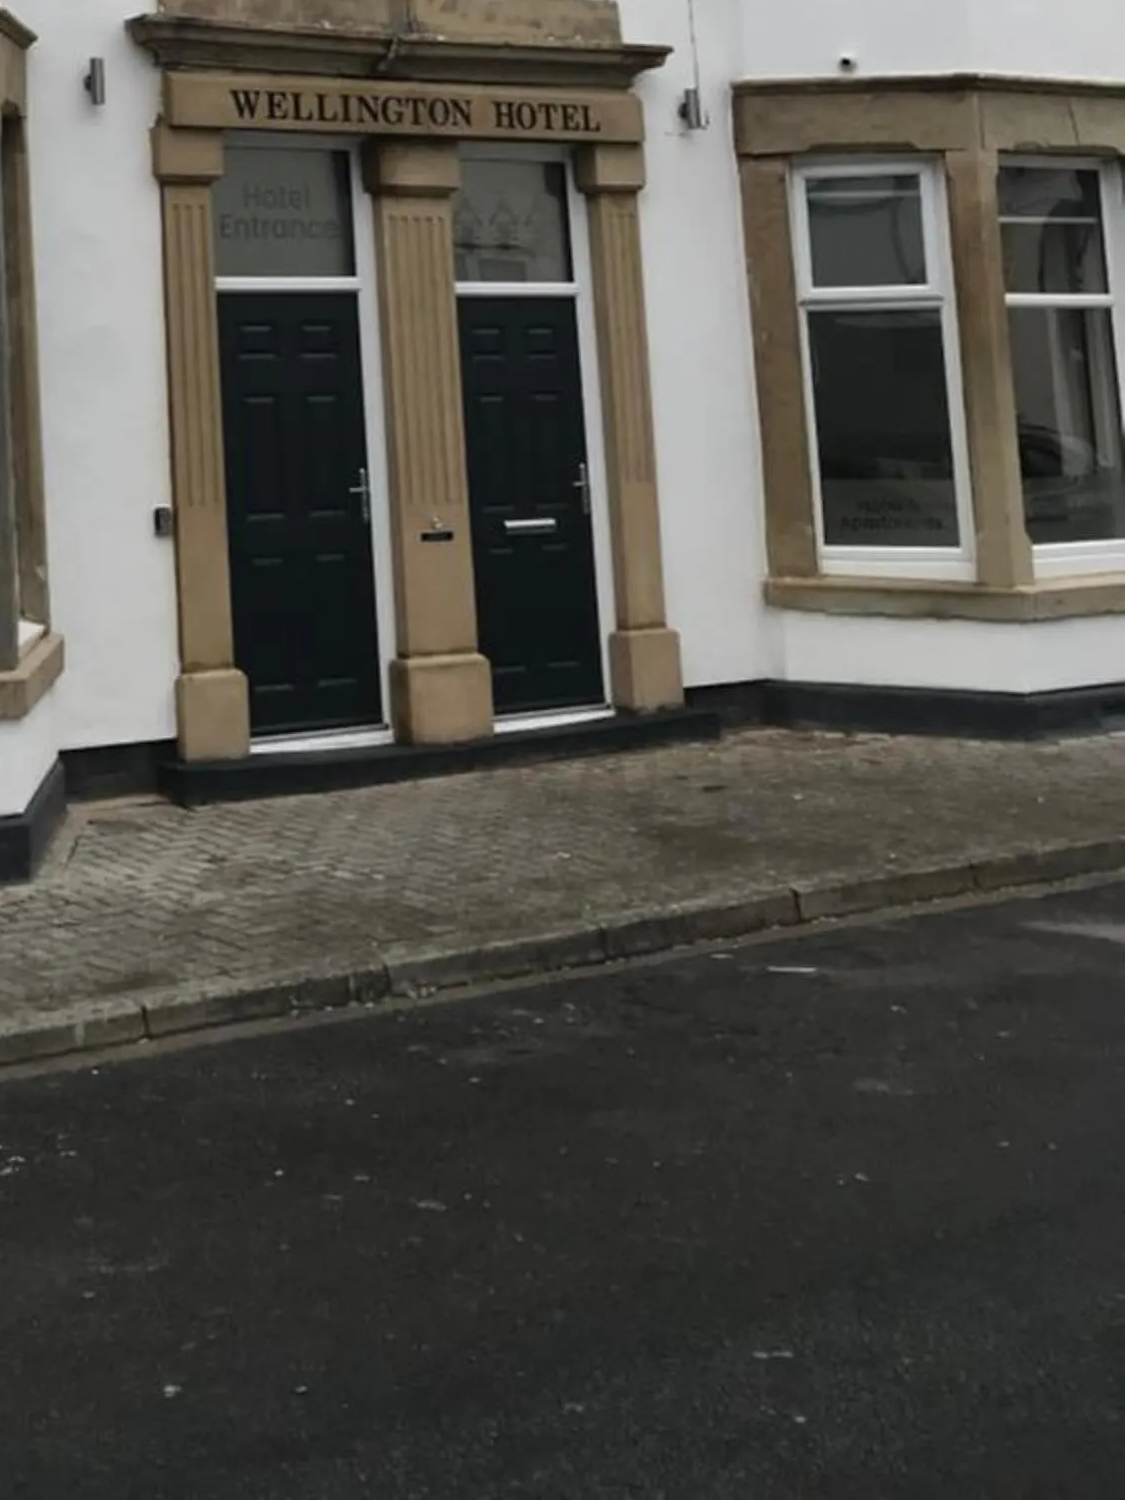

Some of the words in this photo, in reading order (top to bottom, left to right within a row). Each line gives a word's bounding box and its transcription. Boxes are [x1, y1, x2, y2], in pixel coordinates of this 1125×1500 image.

[230, 89, 473, 128] WELLINGTON
[494, 102, 602, 133] HOTEL
[242, 181, 310, 210] Hotel
[219, 212, 343, 241] Entrance
